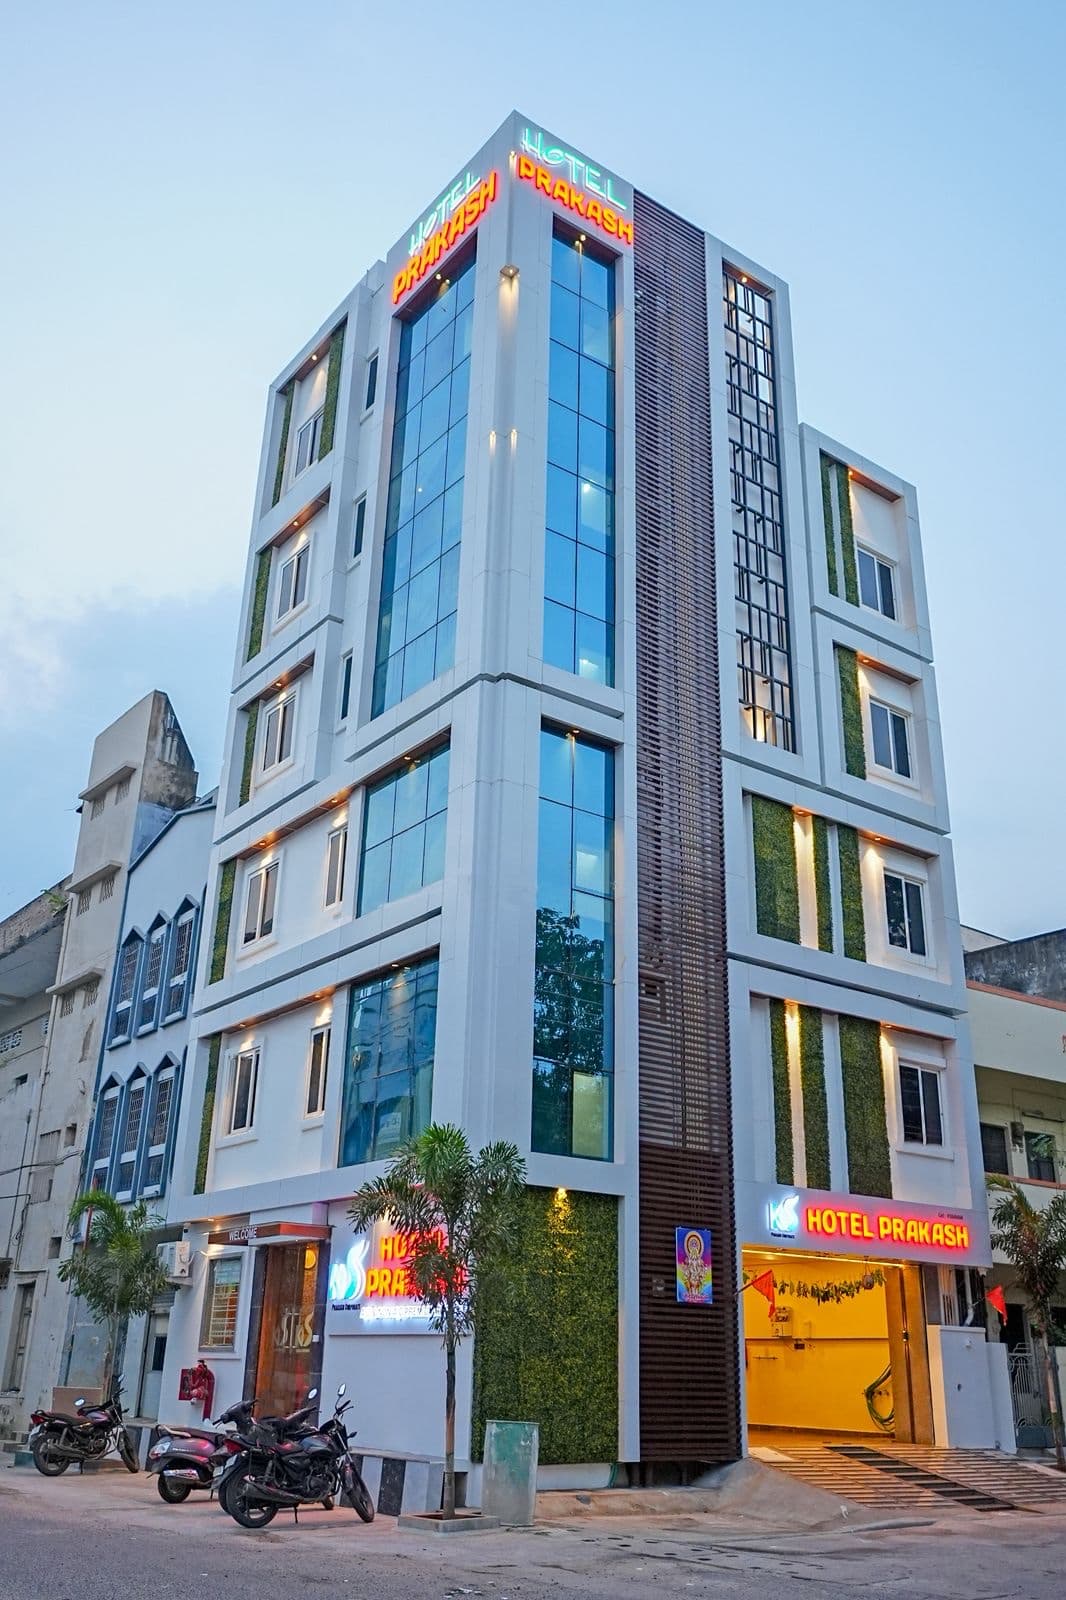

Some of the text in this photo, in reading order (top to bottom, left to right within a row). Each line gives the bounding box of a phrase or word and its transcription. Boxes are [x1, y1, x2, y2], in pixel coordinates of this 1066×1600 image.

[518, 155, 634, 244] PRAKASH
[520, 127, 627, 210] HOTEL
[392, 171, 497, 304] PRAKASH
[408, 172, 481, 256] HOTEL
[228, 1226, 258, 1240] WELCOME
[806, 1207, 970, 1248] HOTEL PRAKASH
